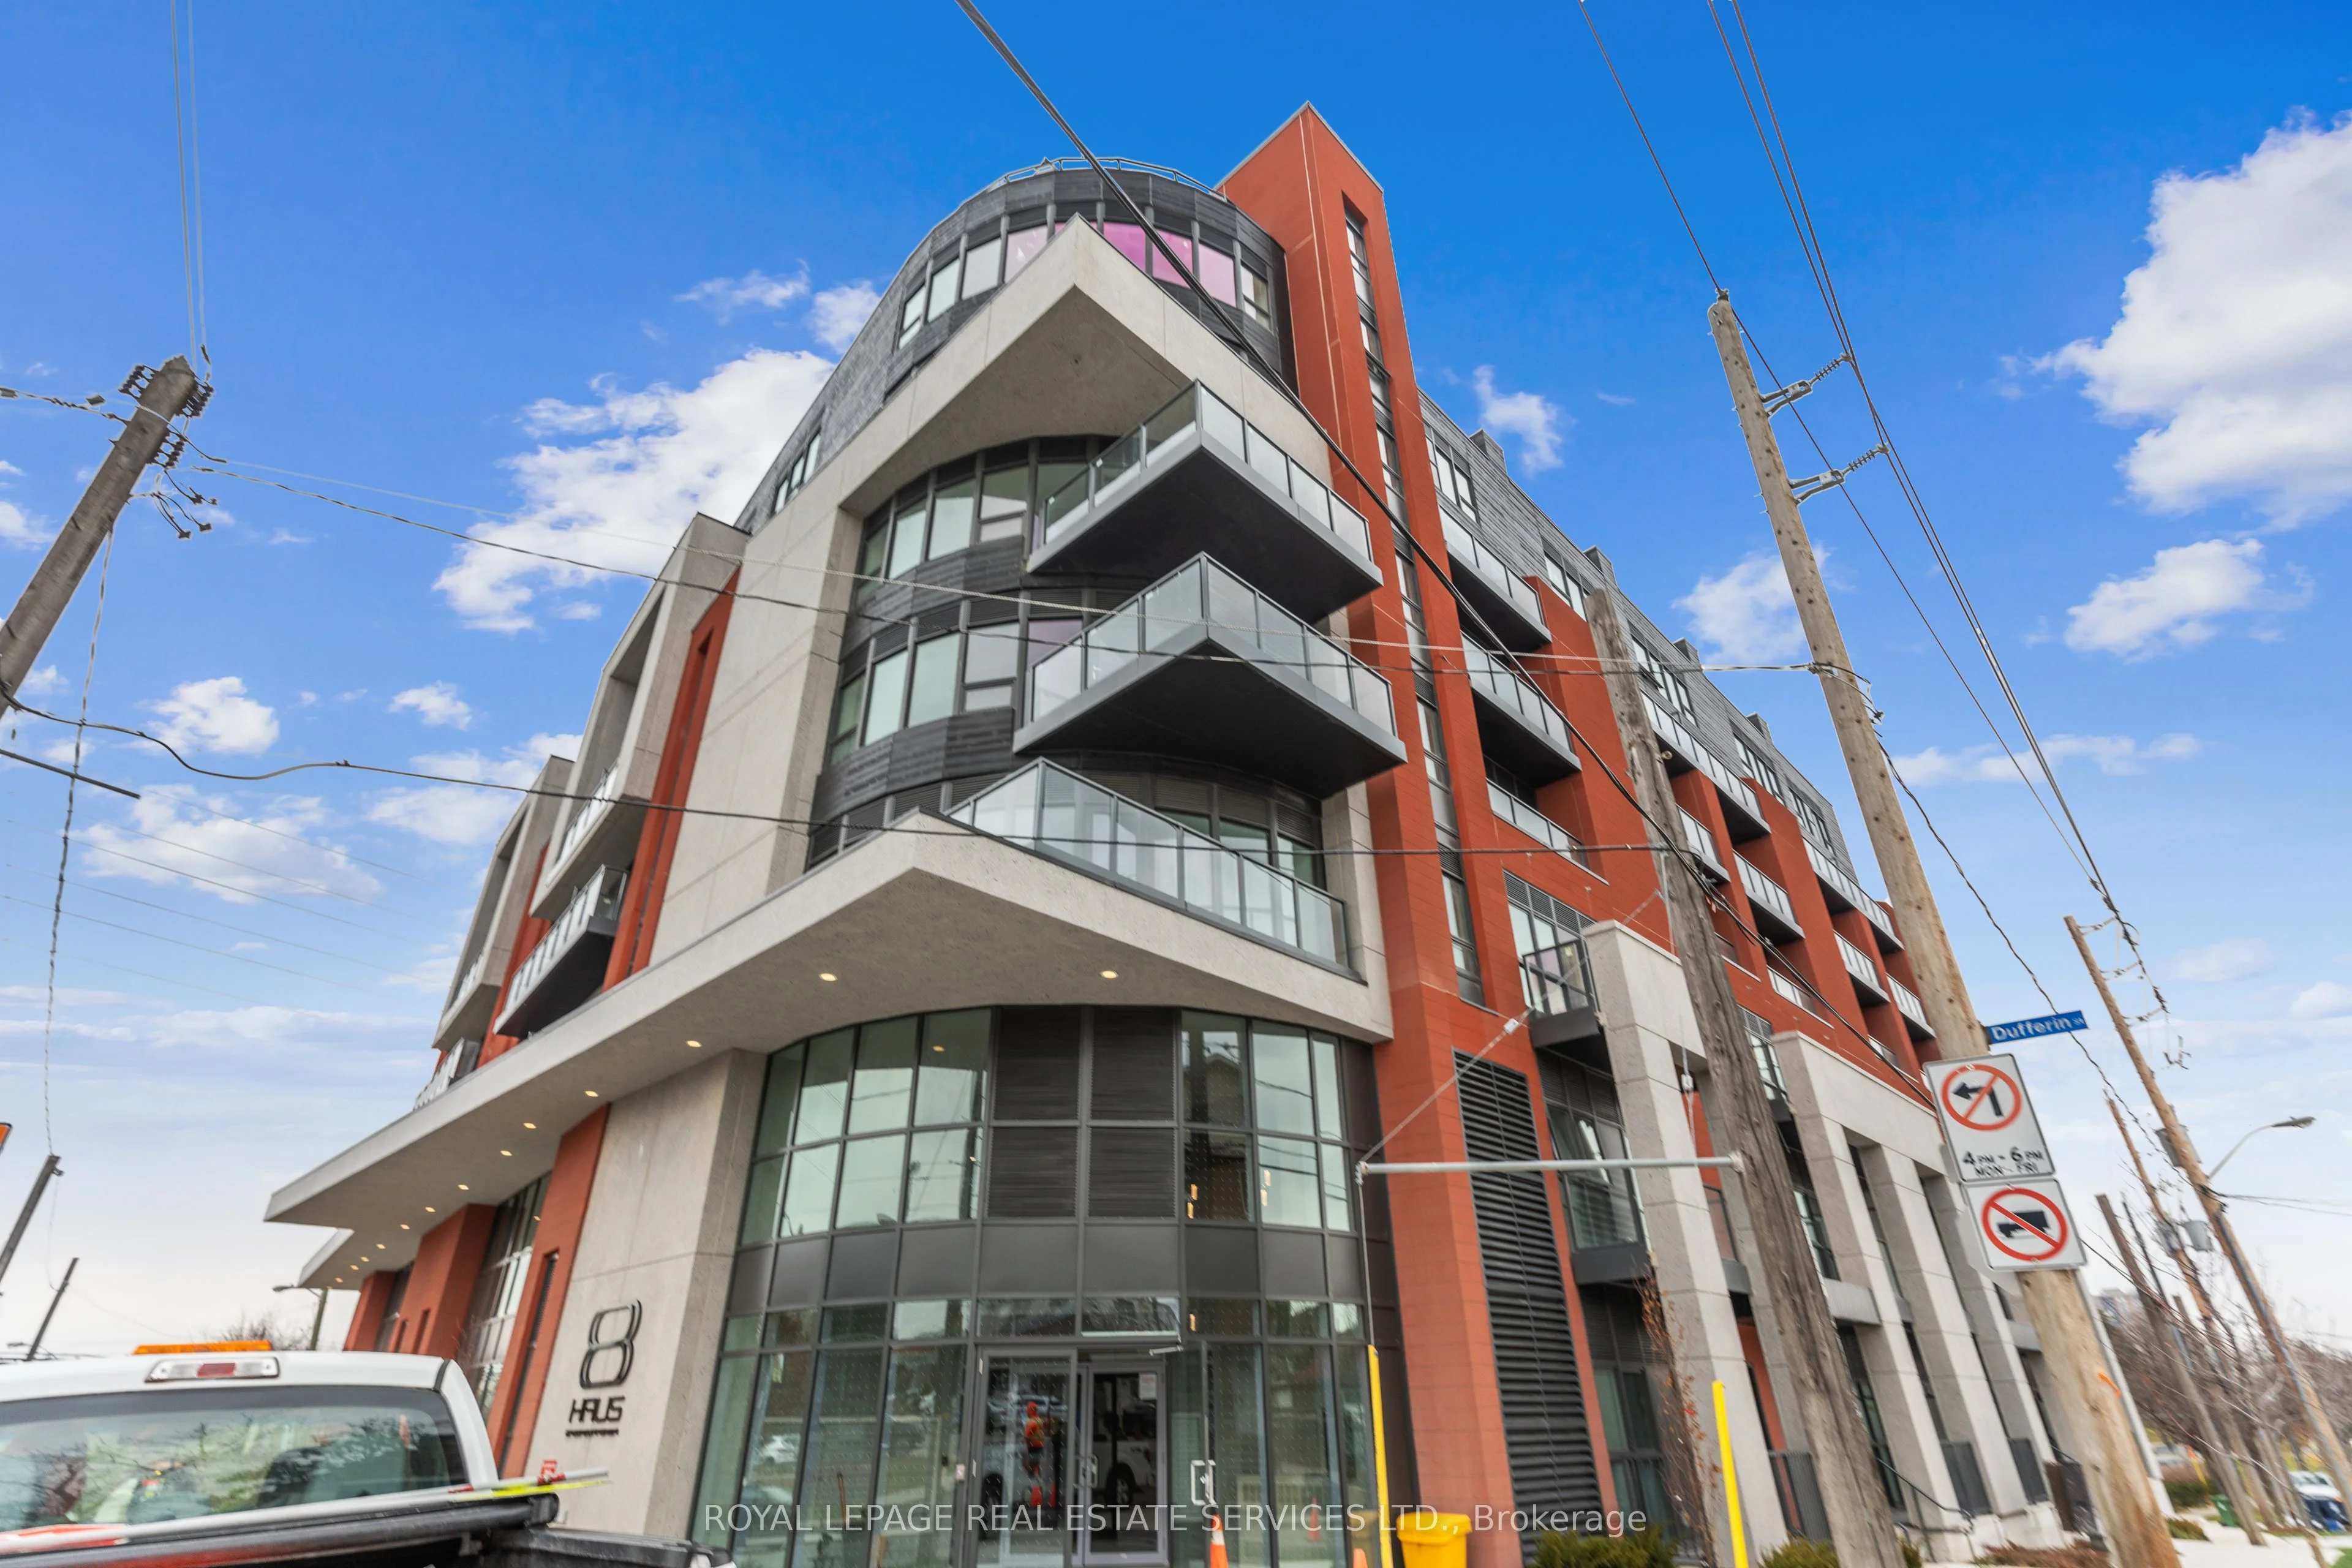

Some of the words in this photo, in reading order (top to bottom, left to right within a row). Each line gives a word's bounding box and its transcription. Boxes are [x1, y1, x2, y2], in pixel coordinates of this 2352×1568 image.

[1991, 1017, 2073, 1041] Dufferin
[579, 1299, 643, 1390] 8
[568, 1395, 625, 1423] HAUS
